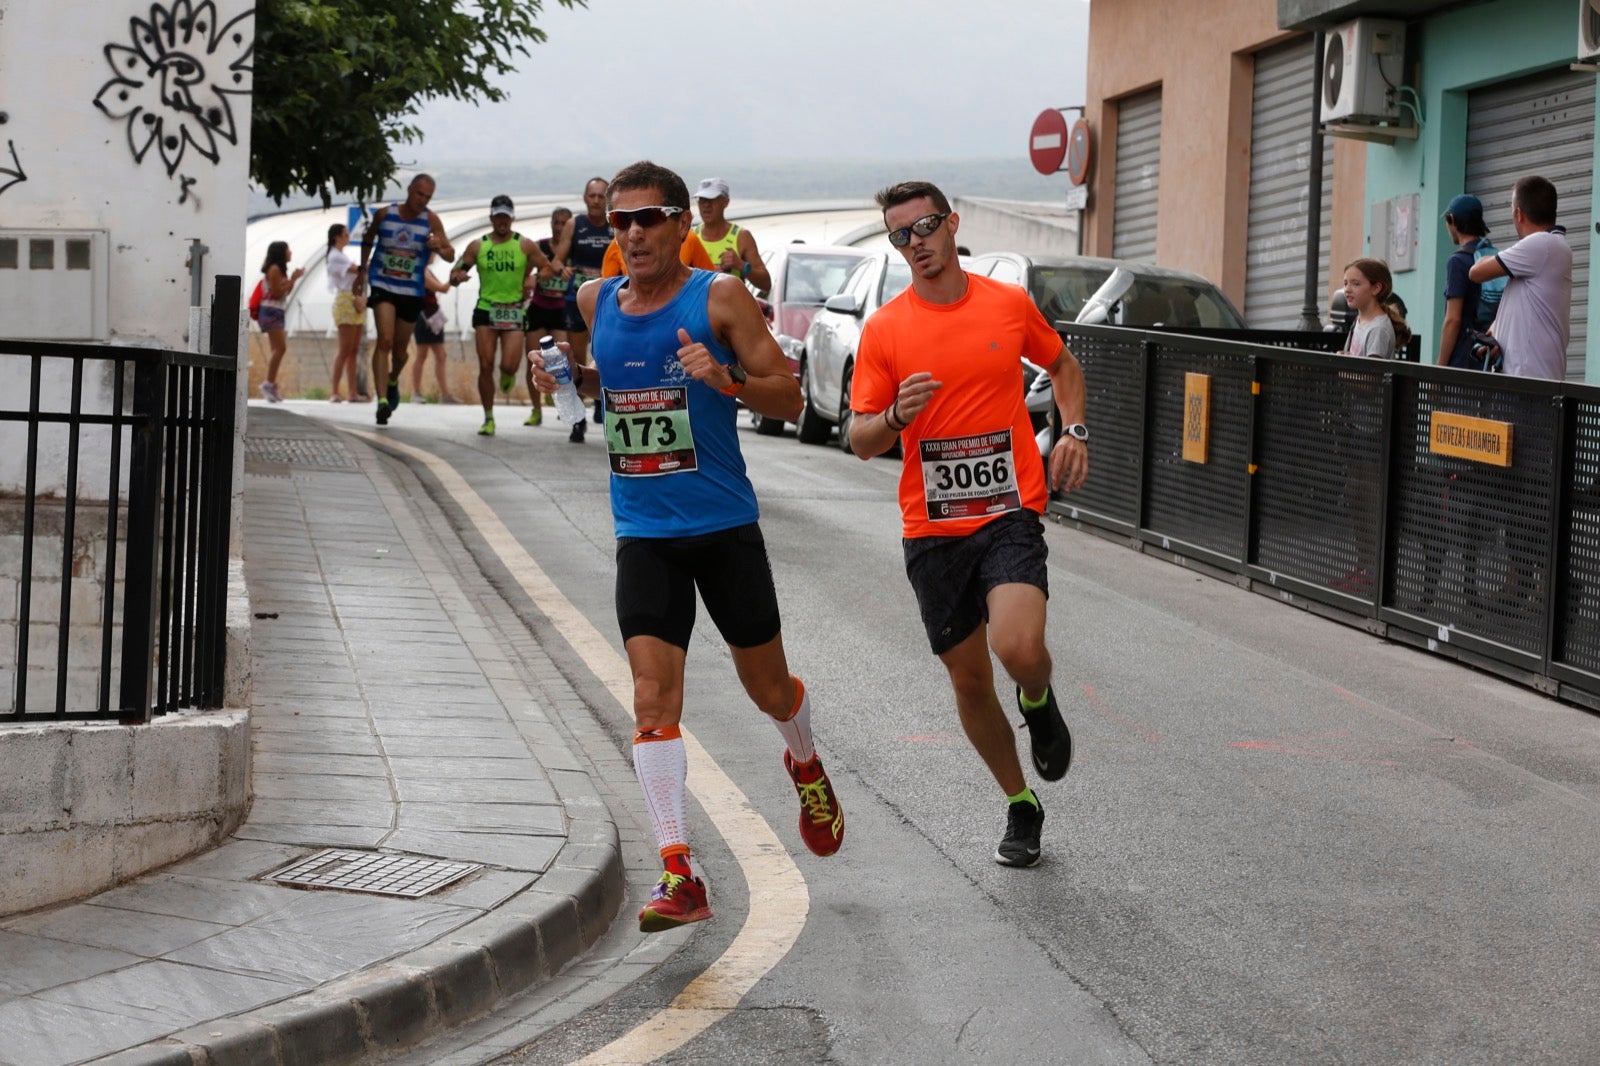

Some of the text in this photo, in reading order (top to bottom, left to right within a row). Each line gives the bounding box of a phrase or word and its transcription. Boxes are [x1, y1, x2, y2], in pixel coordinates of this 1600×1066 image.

[487, 250, 515, 261] RUN
[487, 261, 515, 272] RUN
[496, 309, 518, 320] 883
[627, 391, 650, 403] PREMIO
[650, 391, 659, 401] DE
[660, 389, 680, 401] FONDO
[615, 416, 677, 447] 173
[941, 440, 958, 451] GRAN
[958, 438, 980, 449] PREMIO
[980, 437, 988, 447] DE
[989, 433, 1007, 445] FONDO
[1436, 423, 1501, 456] CERVEZAS ALHAMBRA
[968, 447, 994, 456] CRUZCAMPO
[935, 457, 1009, 490] 3066
